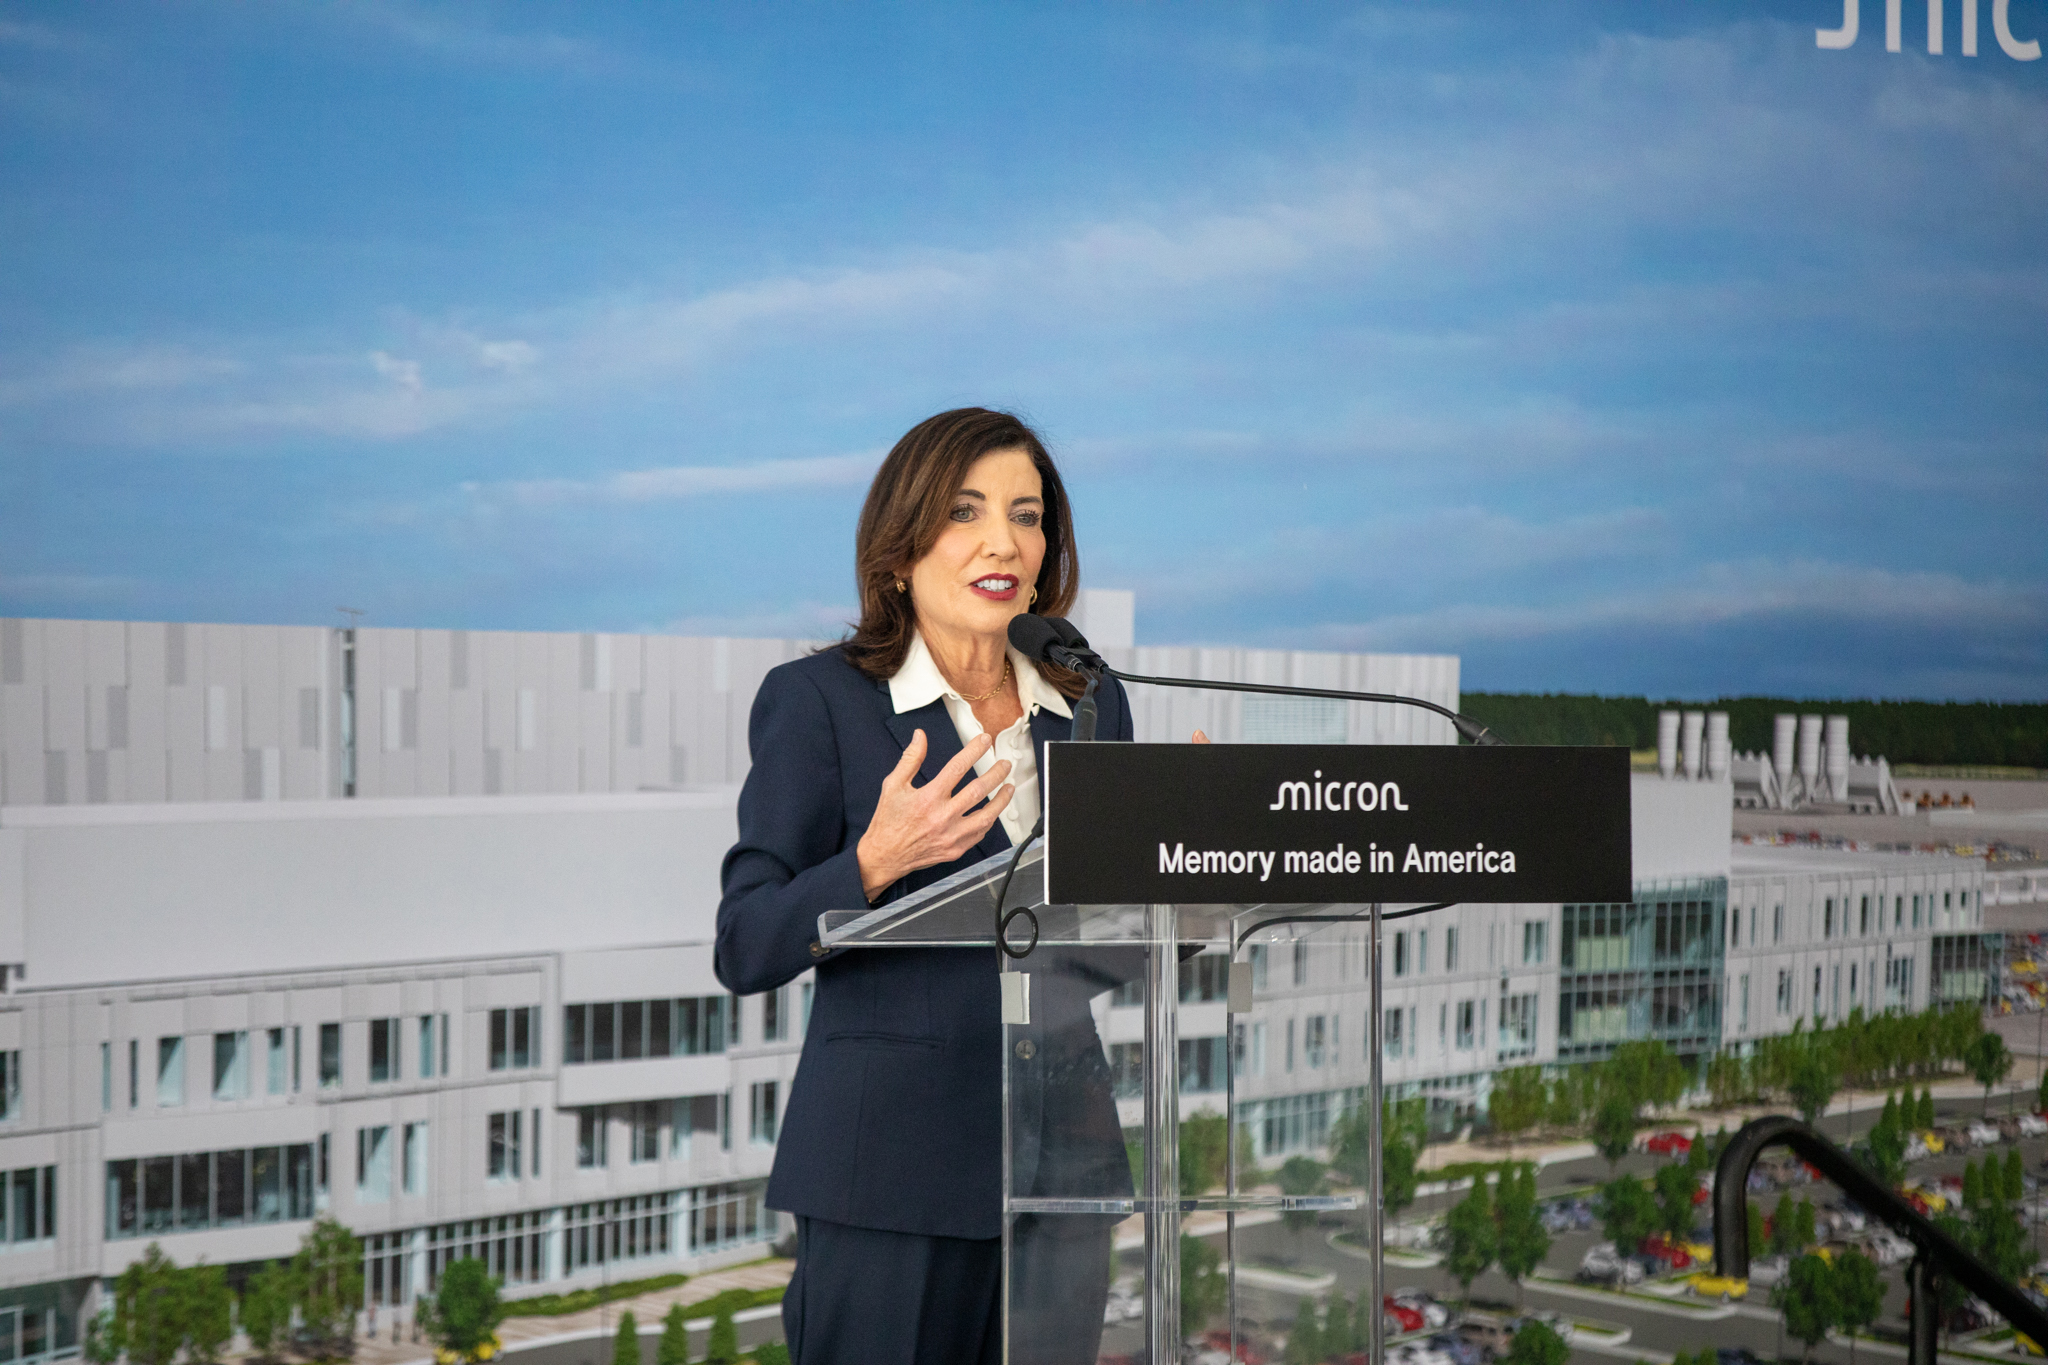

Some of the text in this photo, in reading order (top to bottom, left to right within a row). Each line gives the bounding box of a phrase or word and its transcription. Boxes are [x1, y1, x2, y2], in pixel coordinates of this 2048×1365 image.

[1269, 769, 1409, 812] micron
[1158, 842, 1516, 882] Memory made in America
